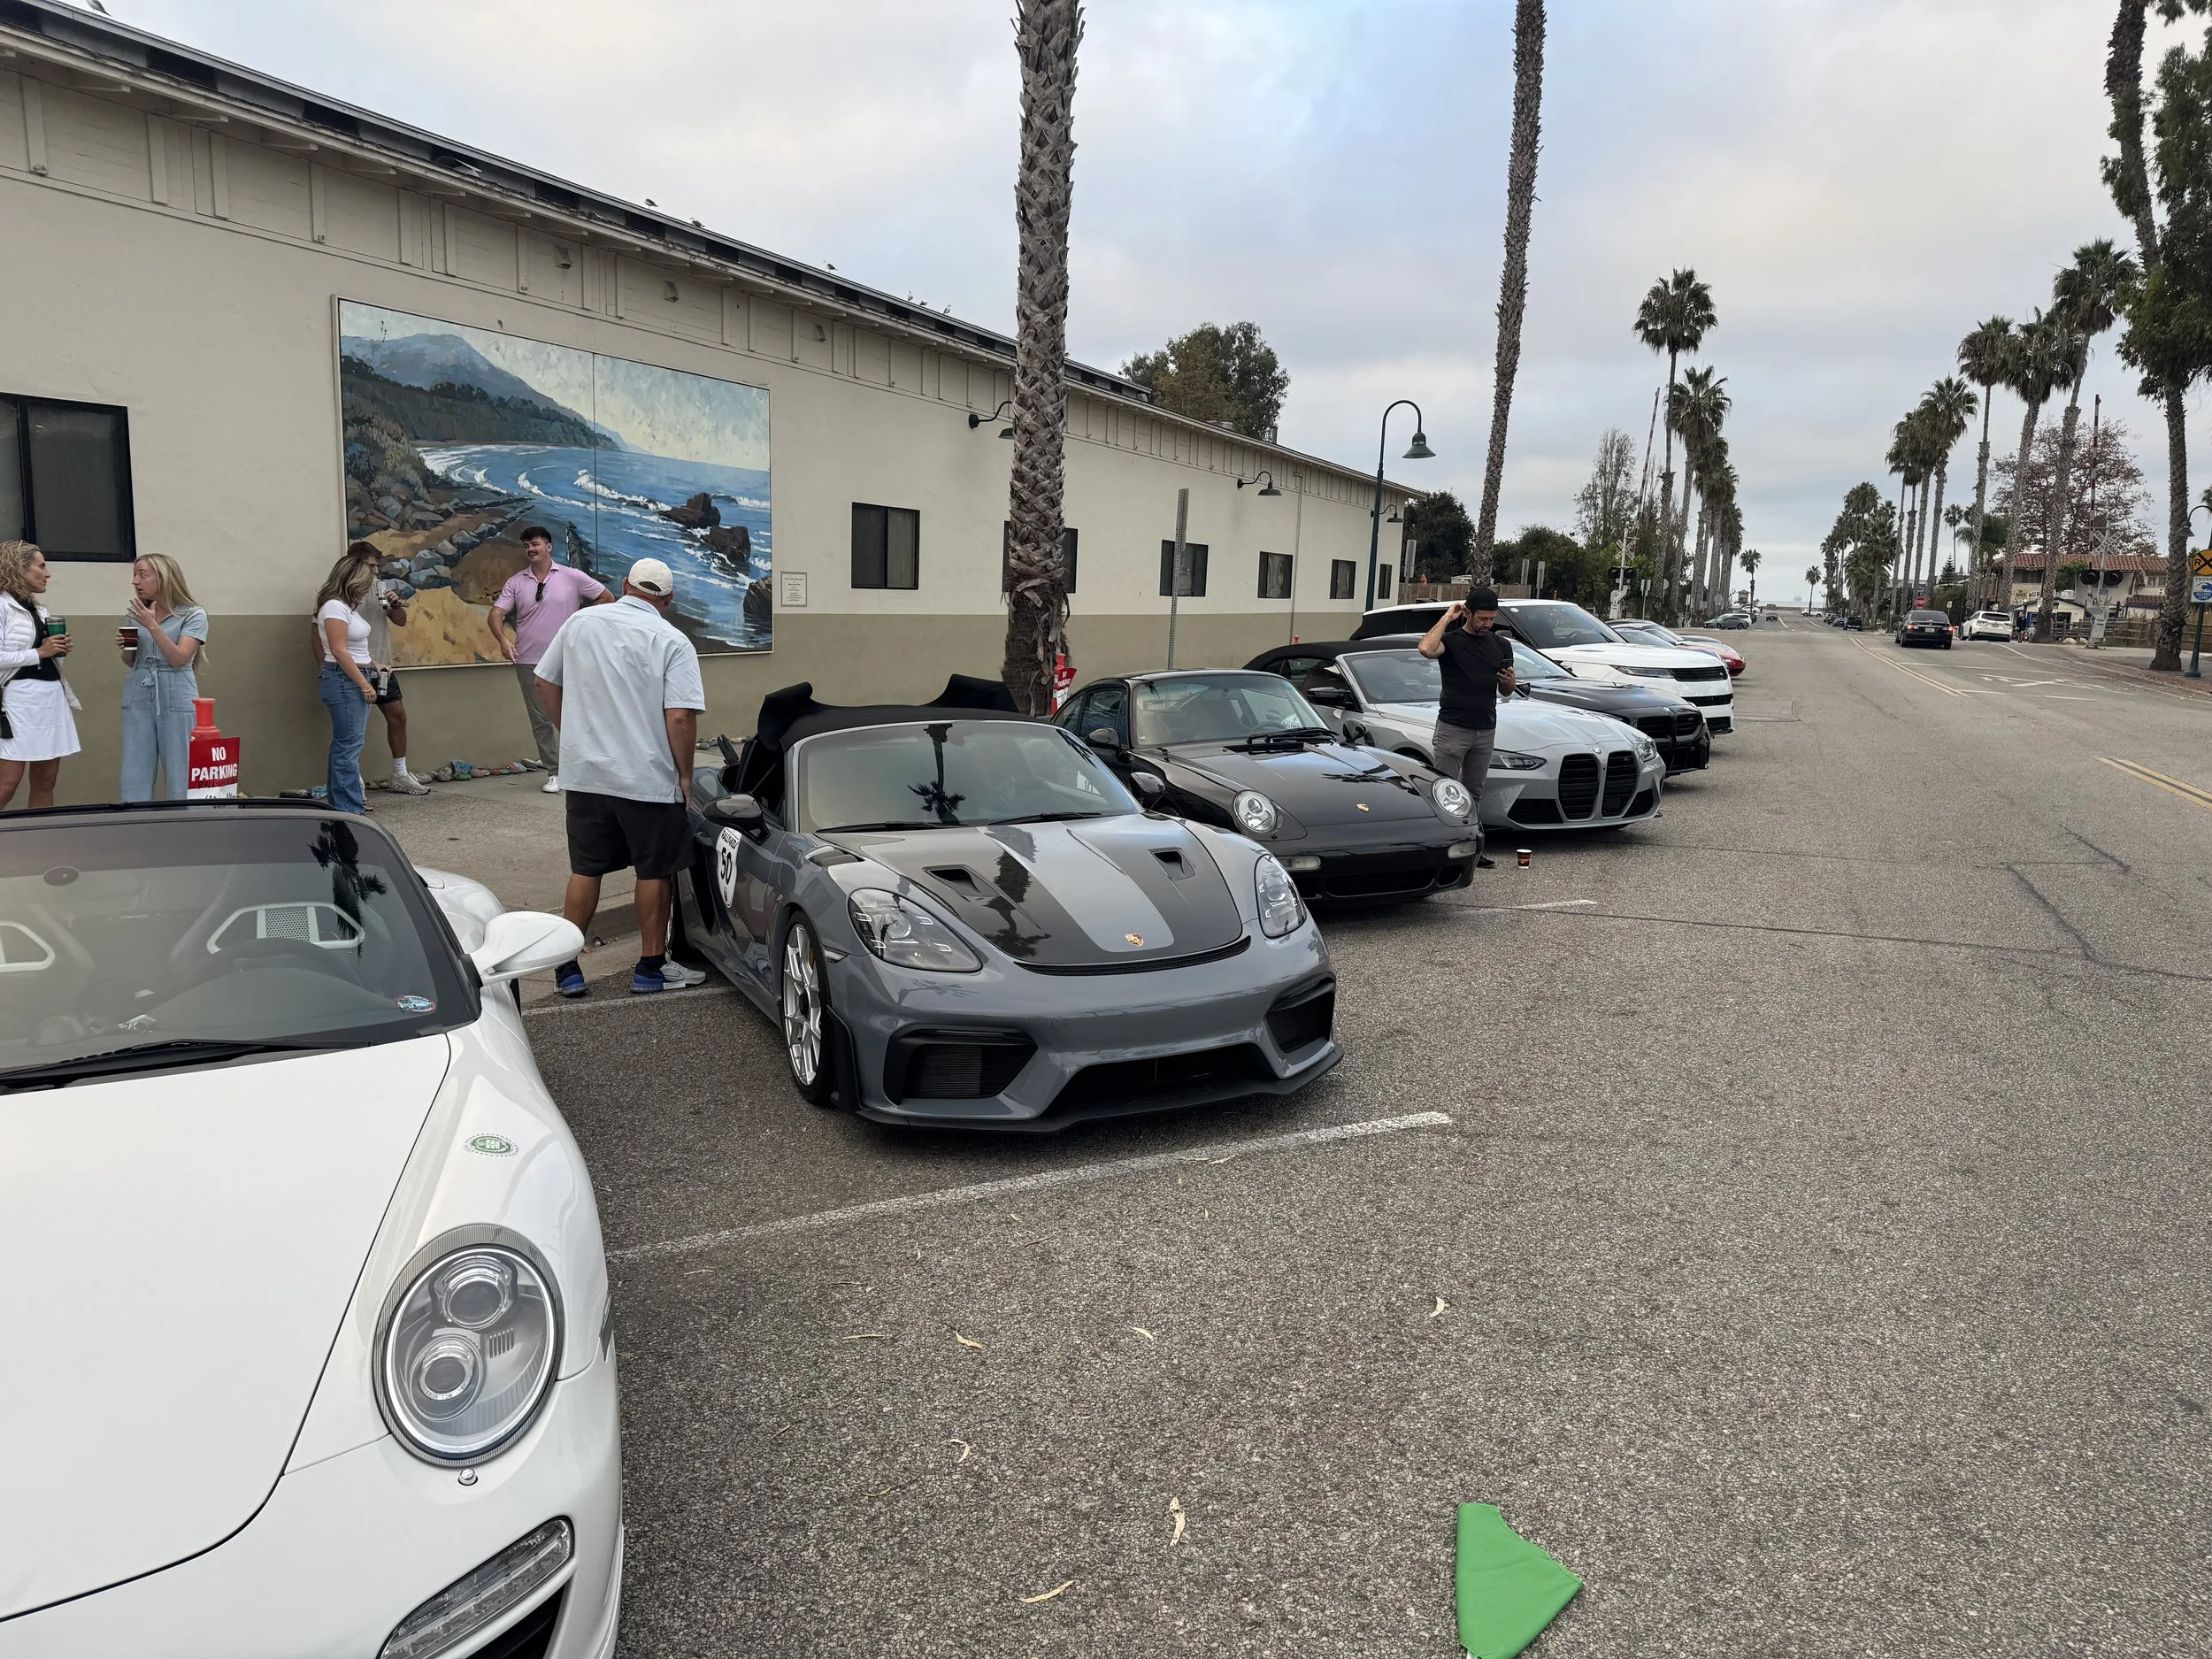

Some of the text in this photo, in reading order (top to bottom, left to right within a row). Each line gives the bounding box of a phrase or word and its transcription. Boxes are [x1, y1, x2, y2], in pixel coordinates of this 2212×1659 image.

[211, 746, 227, 761] NO
[191, 763, 238, 781] PARKING
[720, 846, 733, 885] 50
